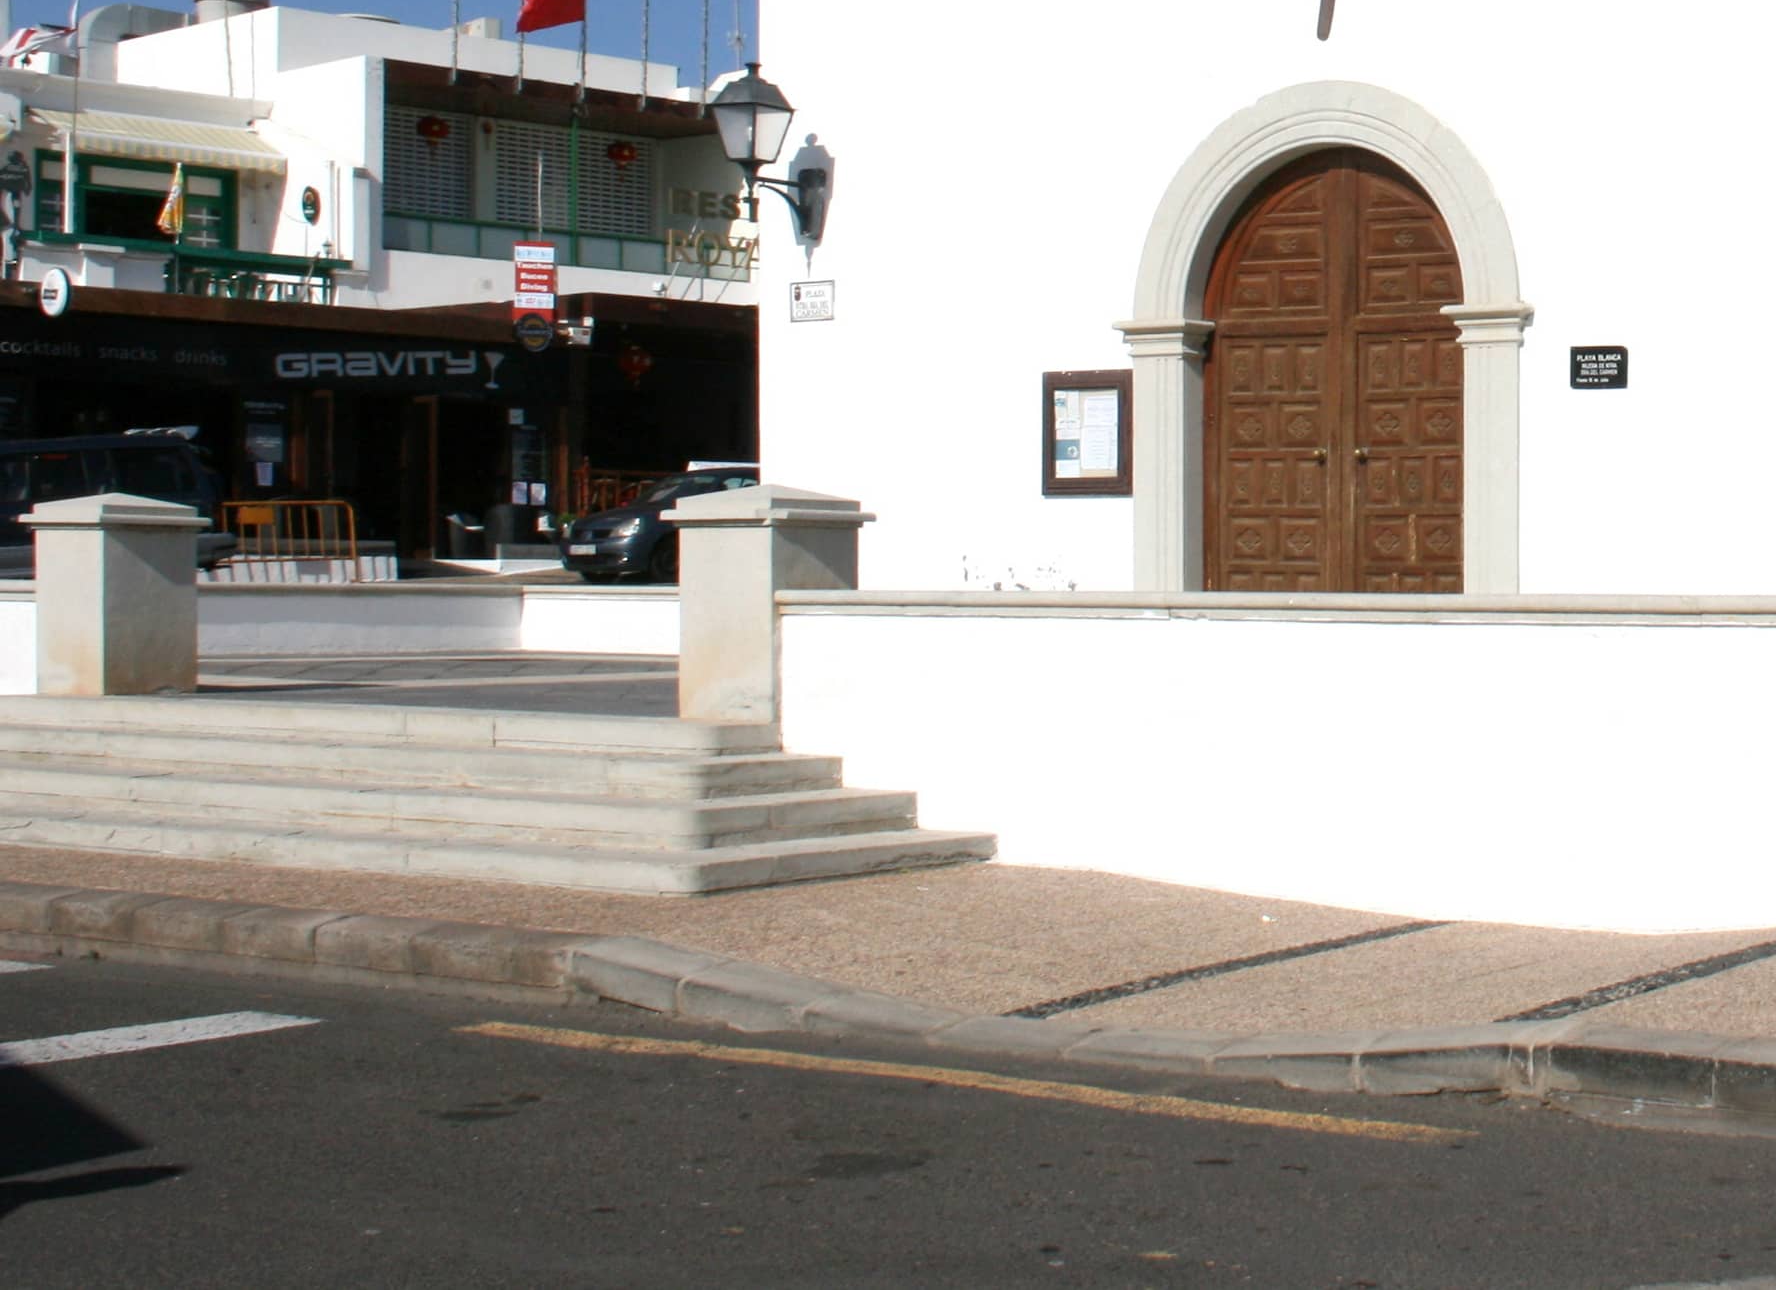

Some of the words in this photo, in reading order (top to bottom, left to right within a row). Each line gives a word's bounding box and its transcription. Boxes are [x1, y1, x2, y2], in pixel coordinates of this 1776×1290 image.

[174, 348, 228, 366] drinks
[1576, 354, 1597, 362] PLAYA
[1597, 353, 1622, 362] BLANCA
